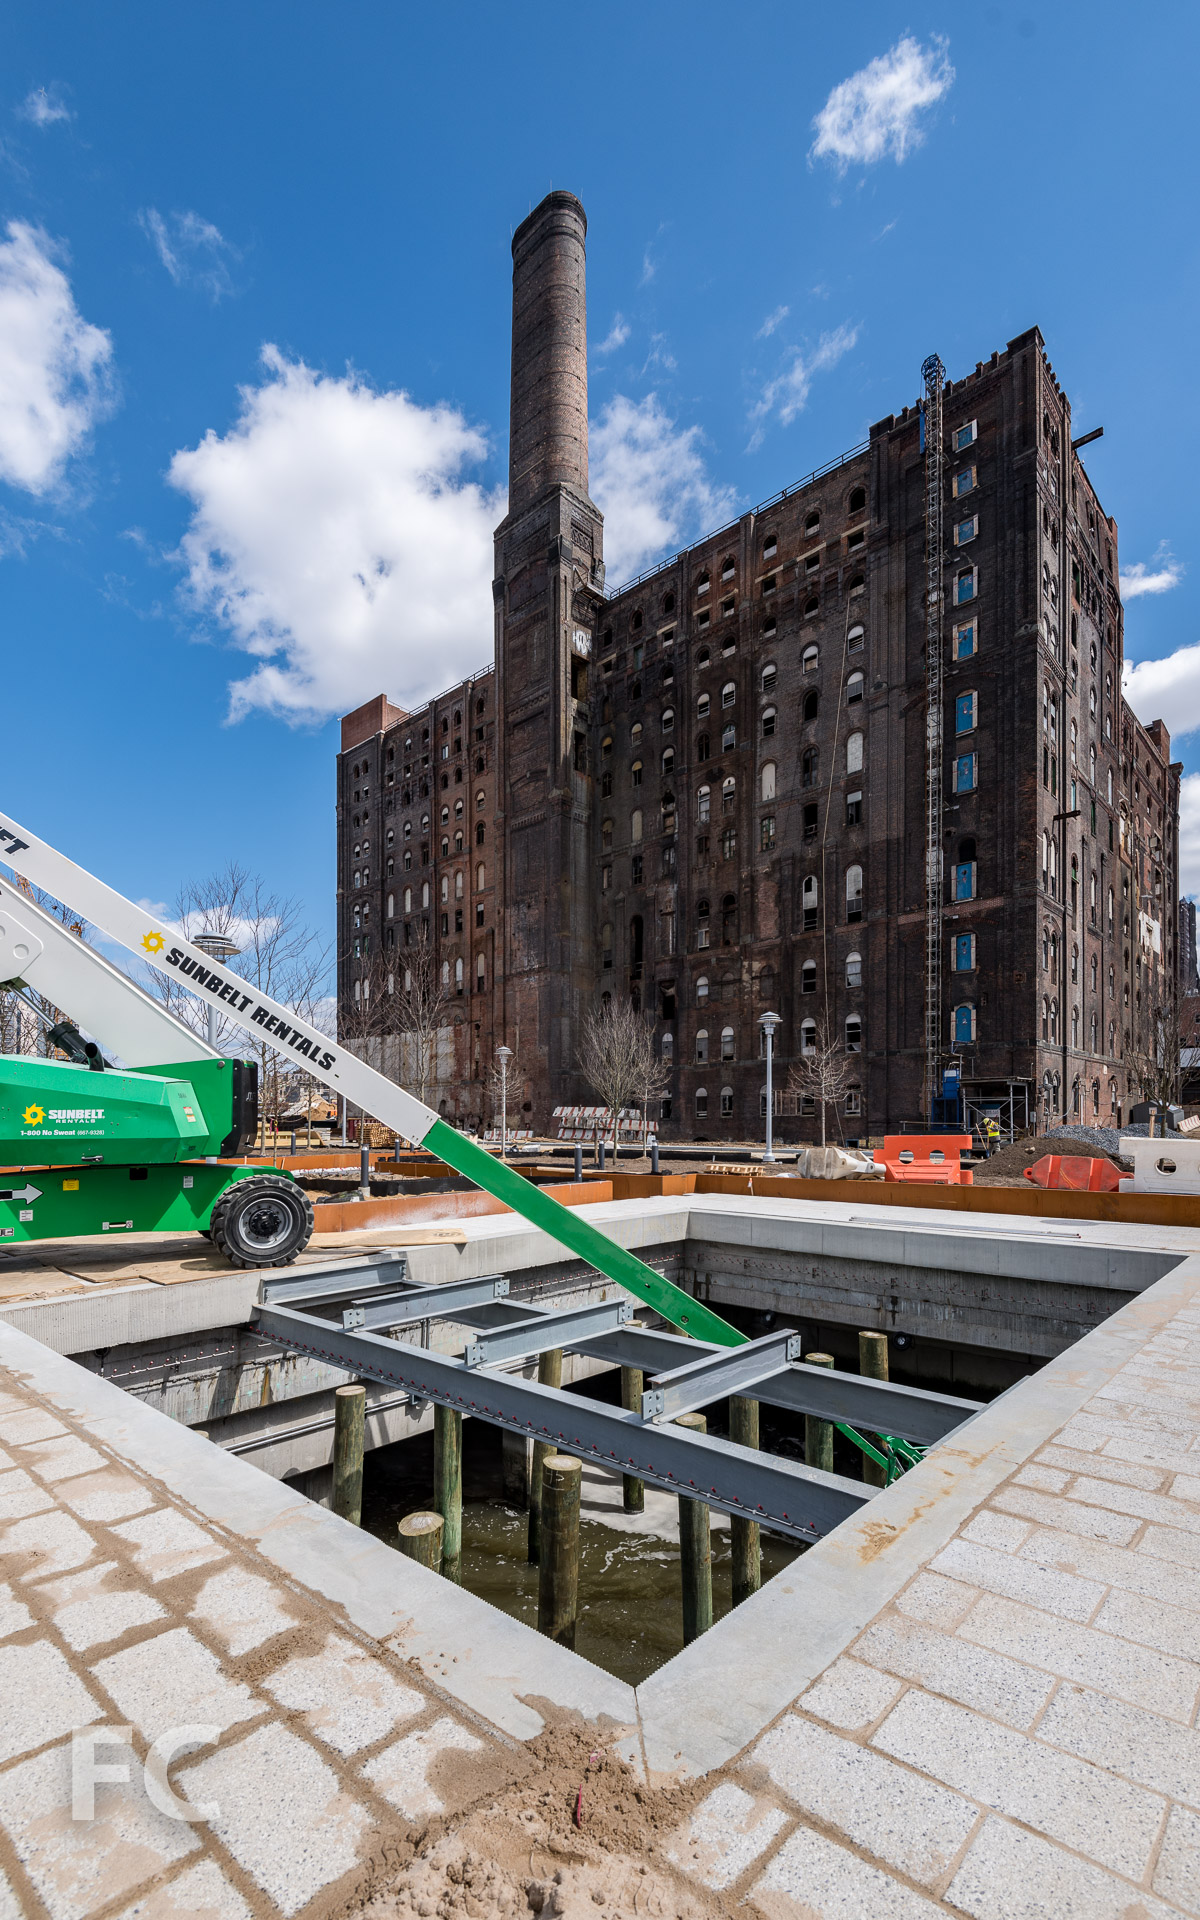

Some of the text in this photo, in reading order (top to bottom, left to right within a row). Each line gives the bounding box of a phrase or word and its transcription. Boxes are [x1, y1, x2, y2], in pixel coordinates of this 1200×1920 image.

[0, 826, 30, 855] FT
[165, 948, 336, 1071] SUNBELT RENTALS
[48, 1109, 105, 1120] SUNBELT
